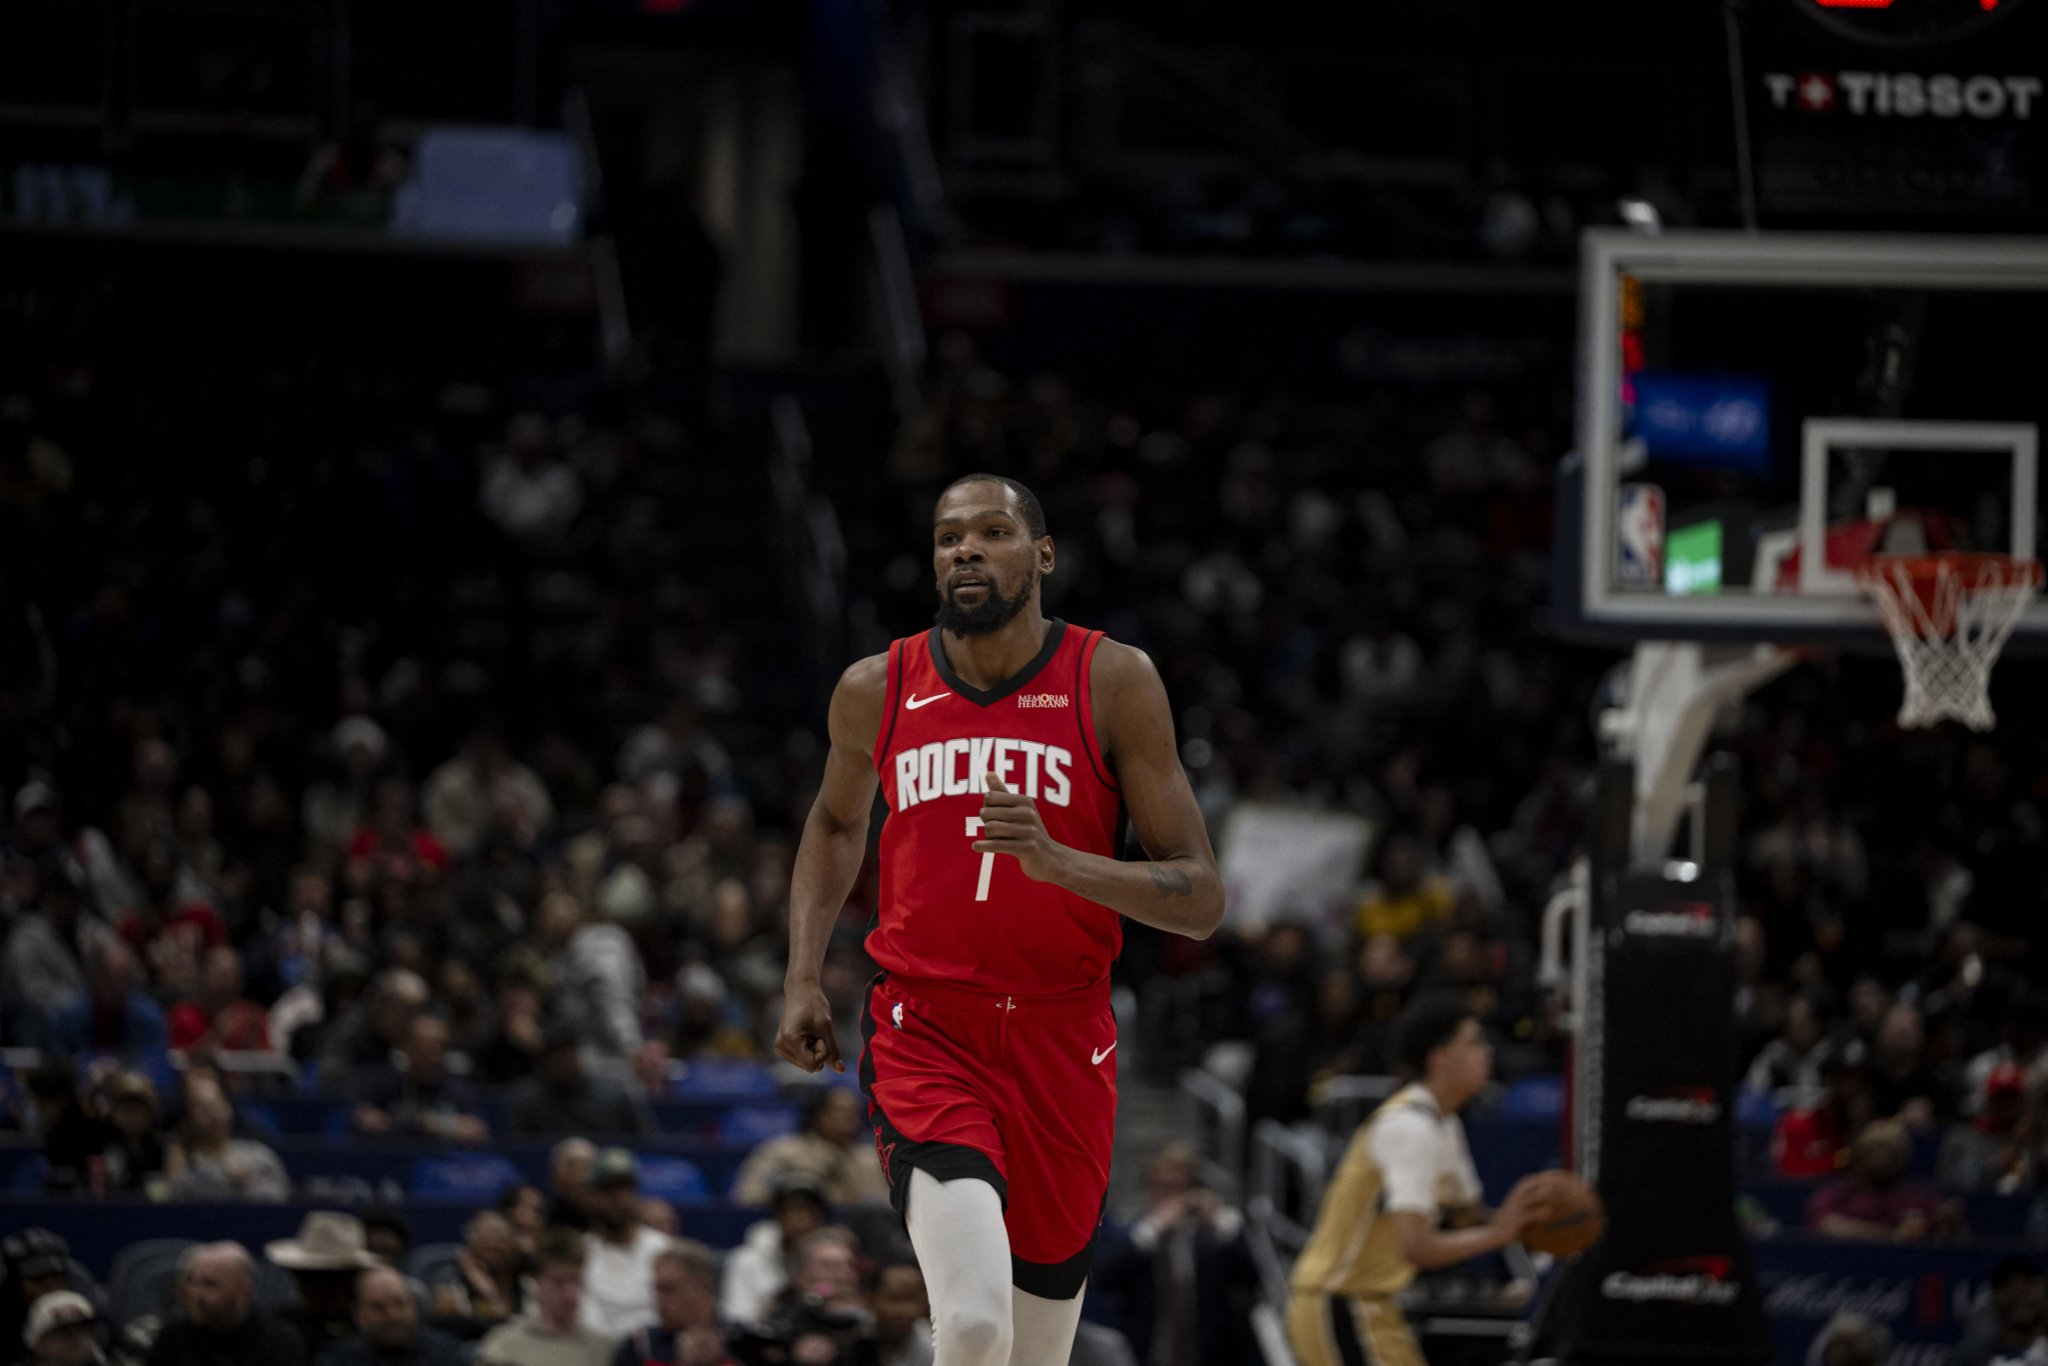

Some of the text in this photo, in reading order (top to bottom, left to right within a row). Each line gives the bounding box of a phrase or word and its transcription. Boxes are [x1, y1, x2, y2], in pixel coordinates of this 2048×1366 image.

[1836, 70, 2044, 122] TISSOT
[1017, 693, 1069, 702] MEMORIAL
[1017, 699, 1069, 709] HERMANN
[895, 737, 1073, 813] ROCKETS
[965, 816, 996, 902] 7
